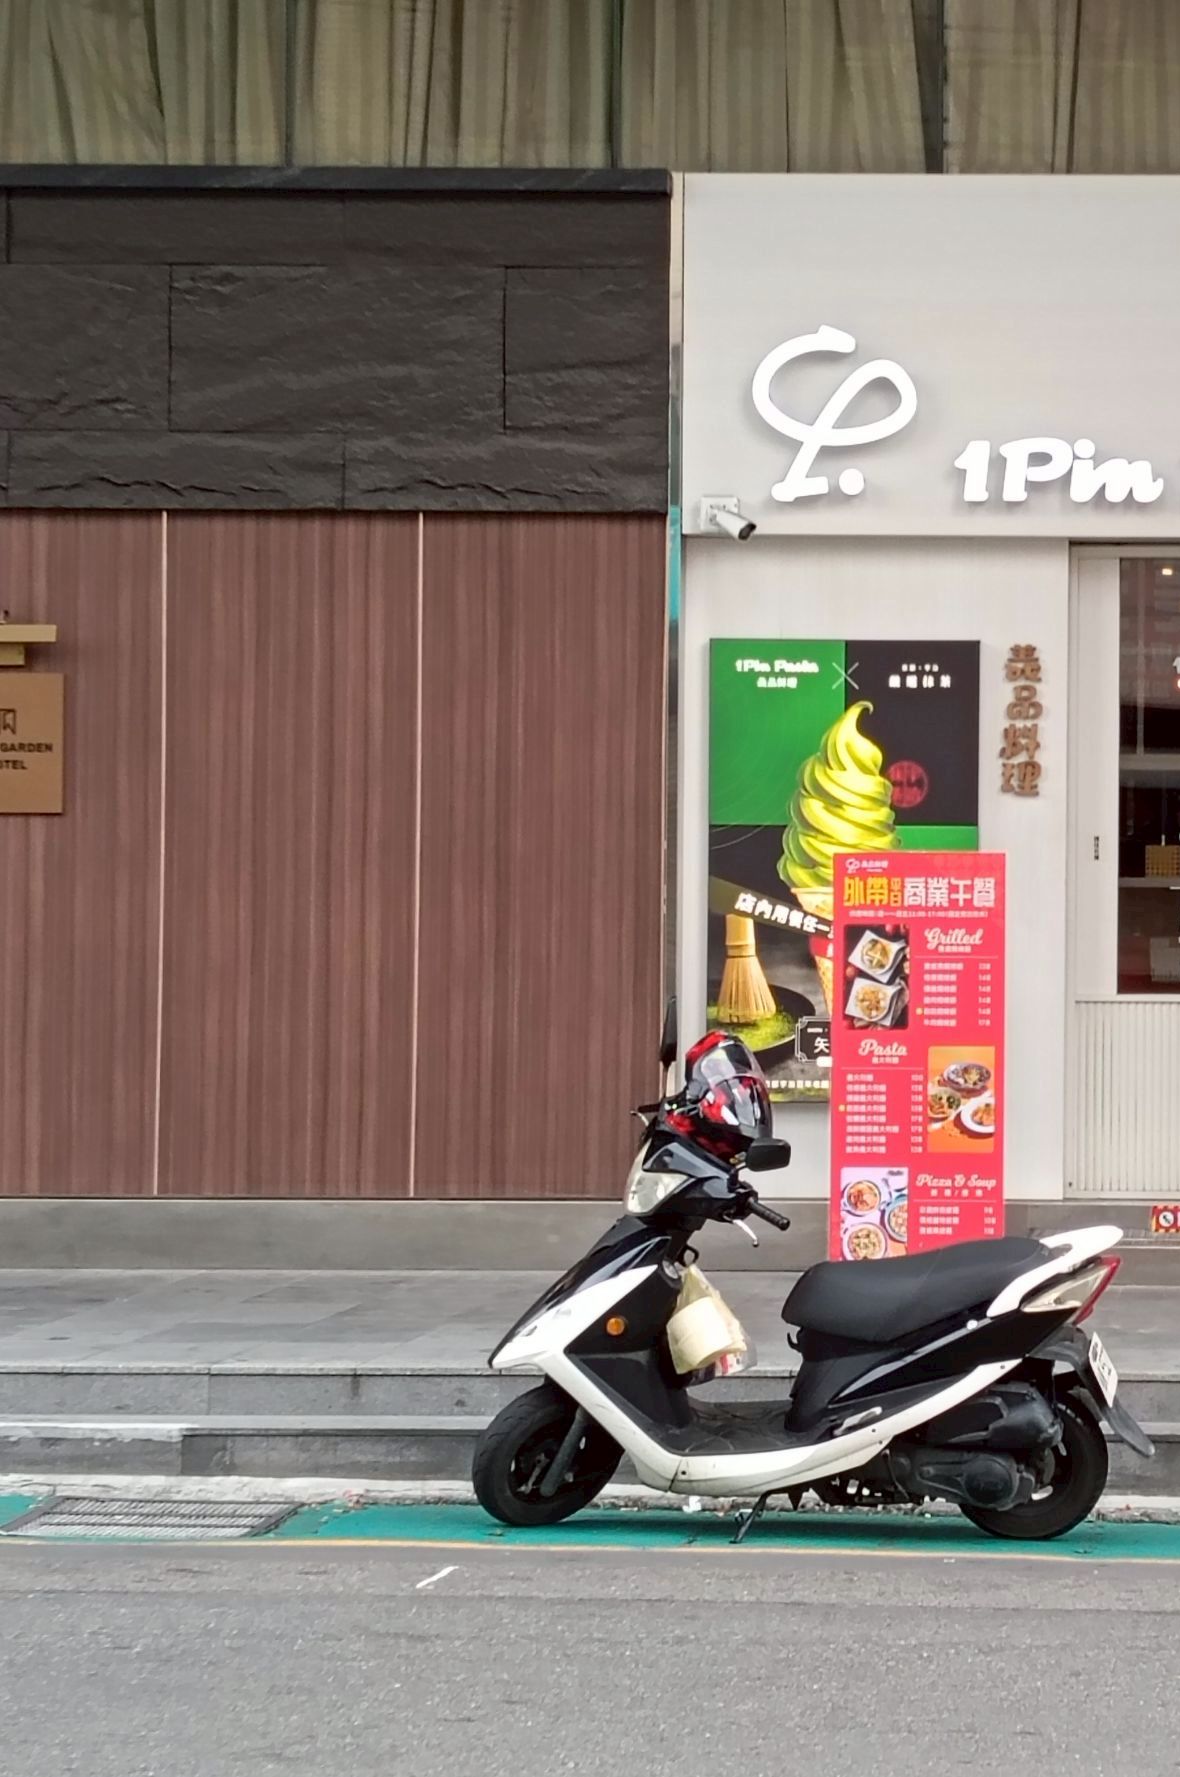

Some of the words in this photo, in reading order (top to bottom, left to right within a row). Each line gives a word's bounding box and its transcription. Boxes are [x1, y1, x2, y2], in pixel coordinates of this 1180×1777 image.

[954, 438, 1163, 503] 1Pin
[0, 742, 53, 752] GARDEN
[734, 893, 834, 939] 店內用餐任一
[924, 927, 984, 951] Grilled
[858, 1039, 908, 1056] Pasta
[916, 1174, 952, 1187] Pizza
[967, 1174, 997, 1191] Soup
